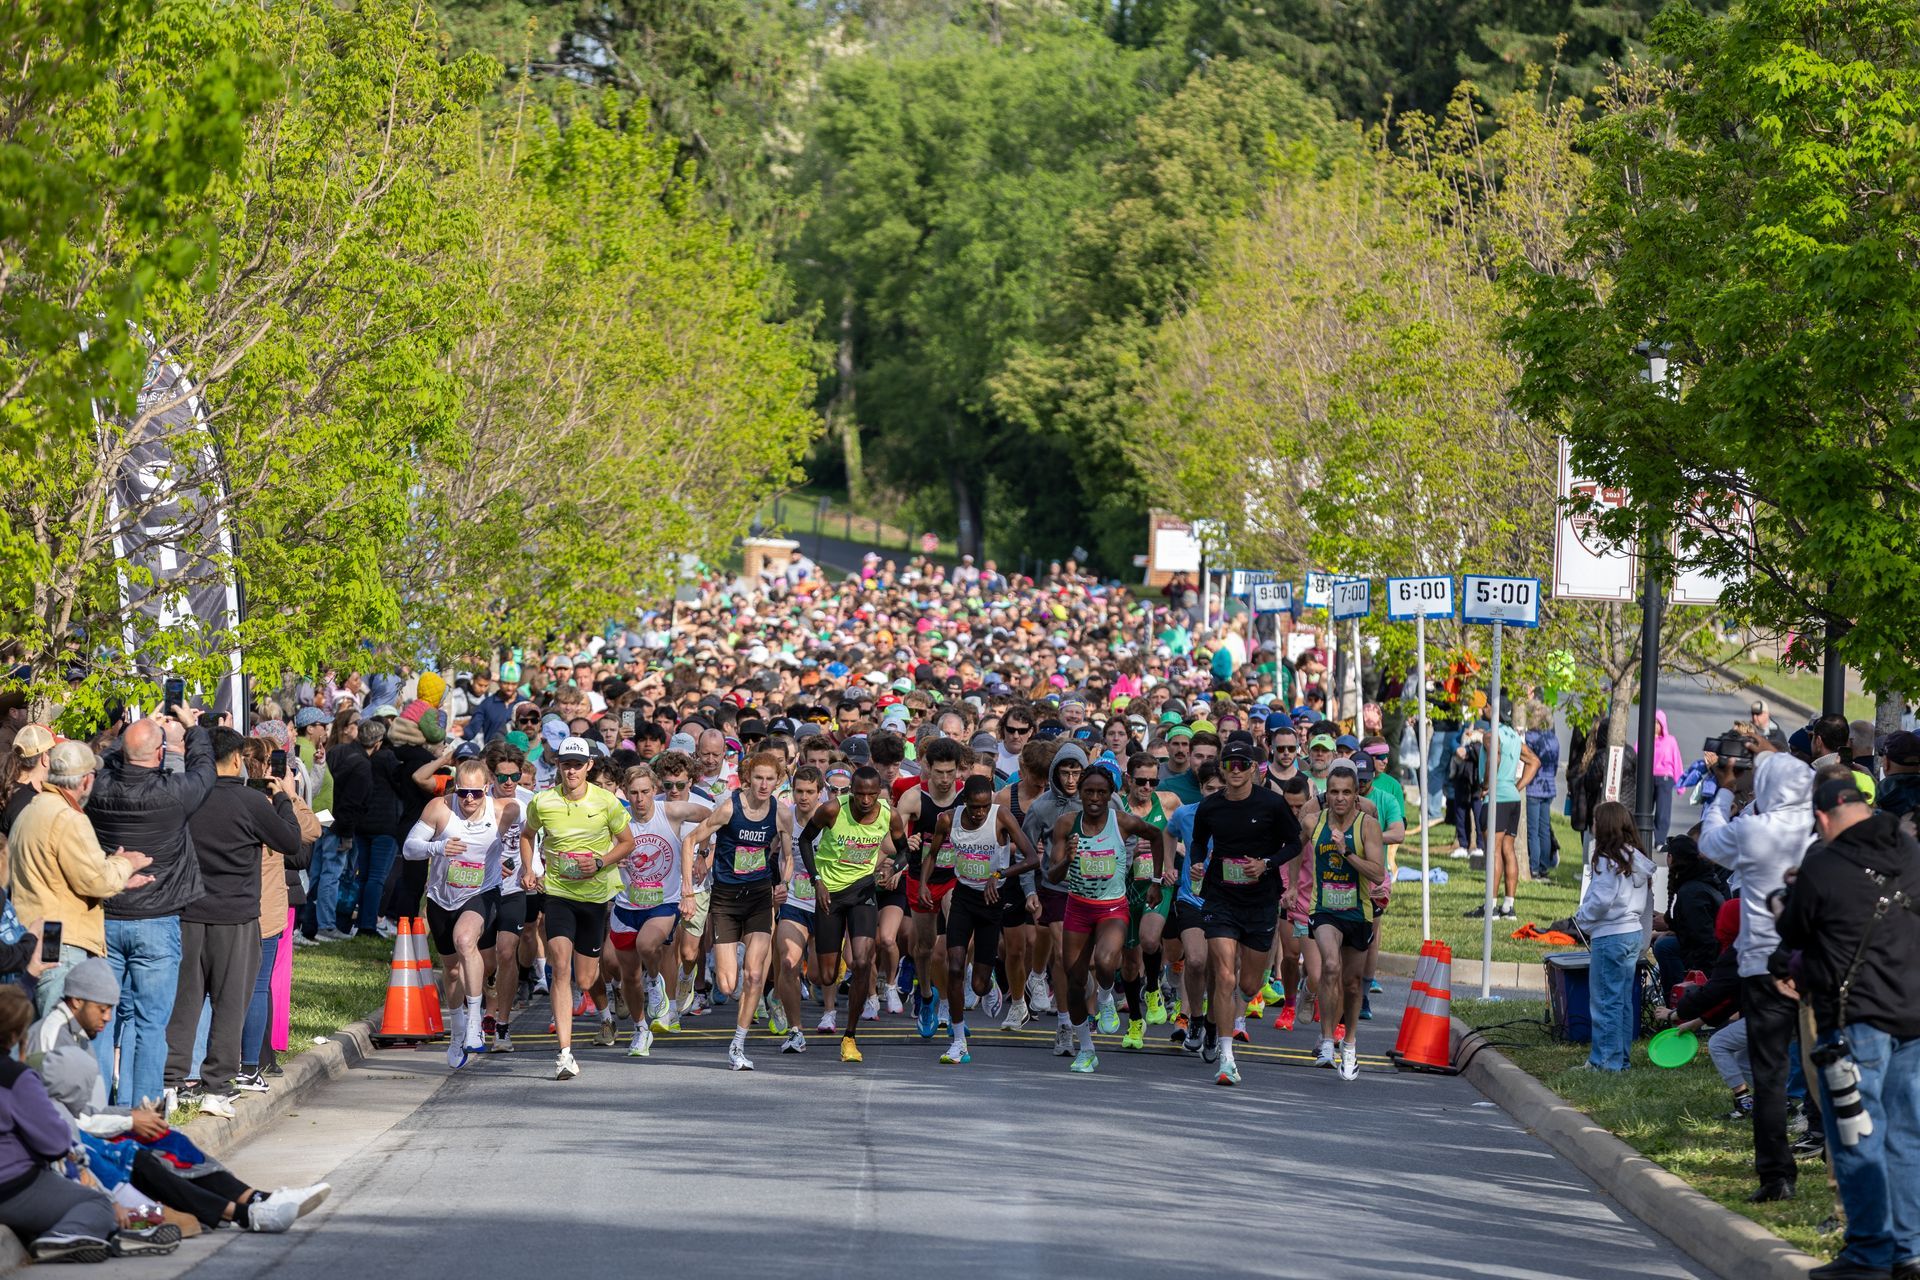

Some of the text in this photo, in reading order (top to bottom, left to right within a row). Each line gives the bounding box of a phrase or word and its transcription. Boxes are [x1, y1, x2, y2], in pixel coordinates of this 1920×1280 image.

[1260, 587, 1287, 599] 9:00
[1341, 585, 1365, 602] 7:00
[1400, 582, 1445, 600] 6:00
[1477, 582, 1529, 604] 5:00
[738, 829, 767, 842] CROZET
[961, 862, 985, 875] 2590
[1086, 860, 1110, 872] 2591
[454, 869, 479, 882] 2953
[634, 890, 659, 902] 2730
